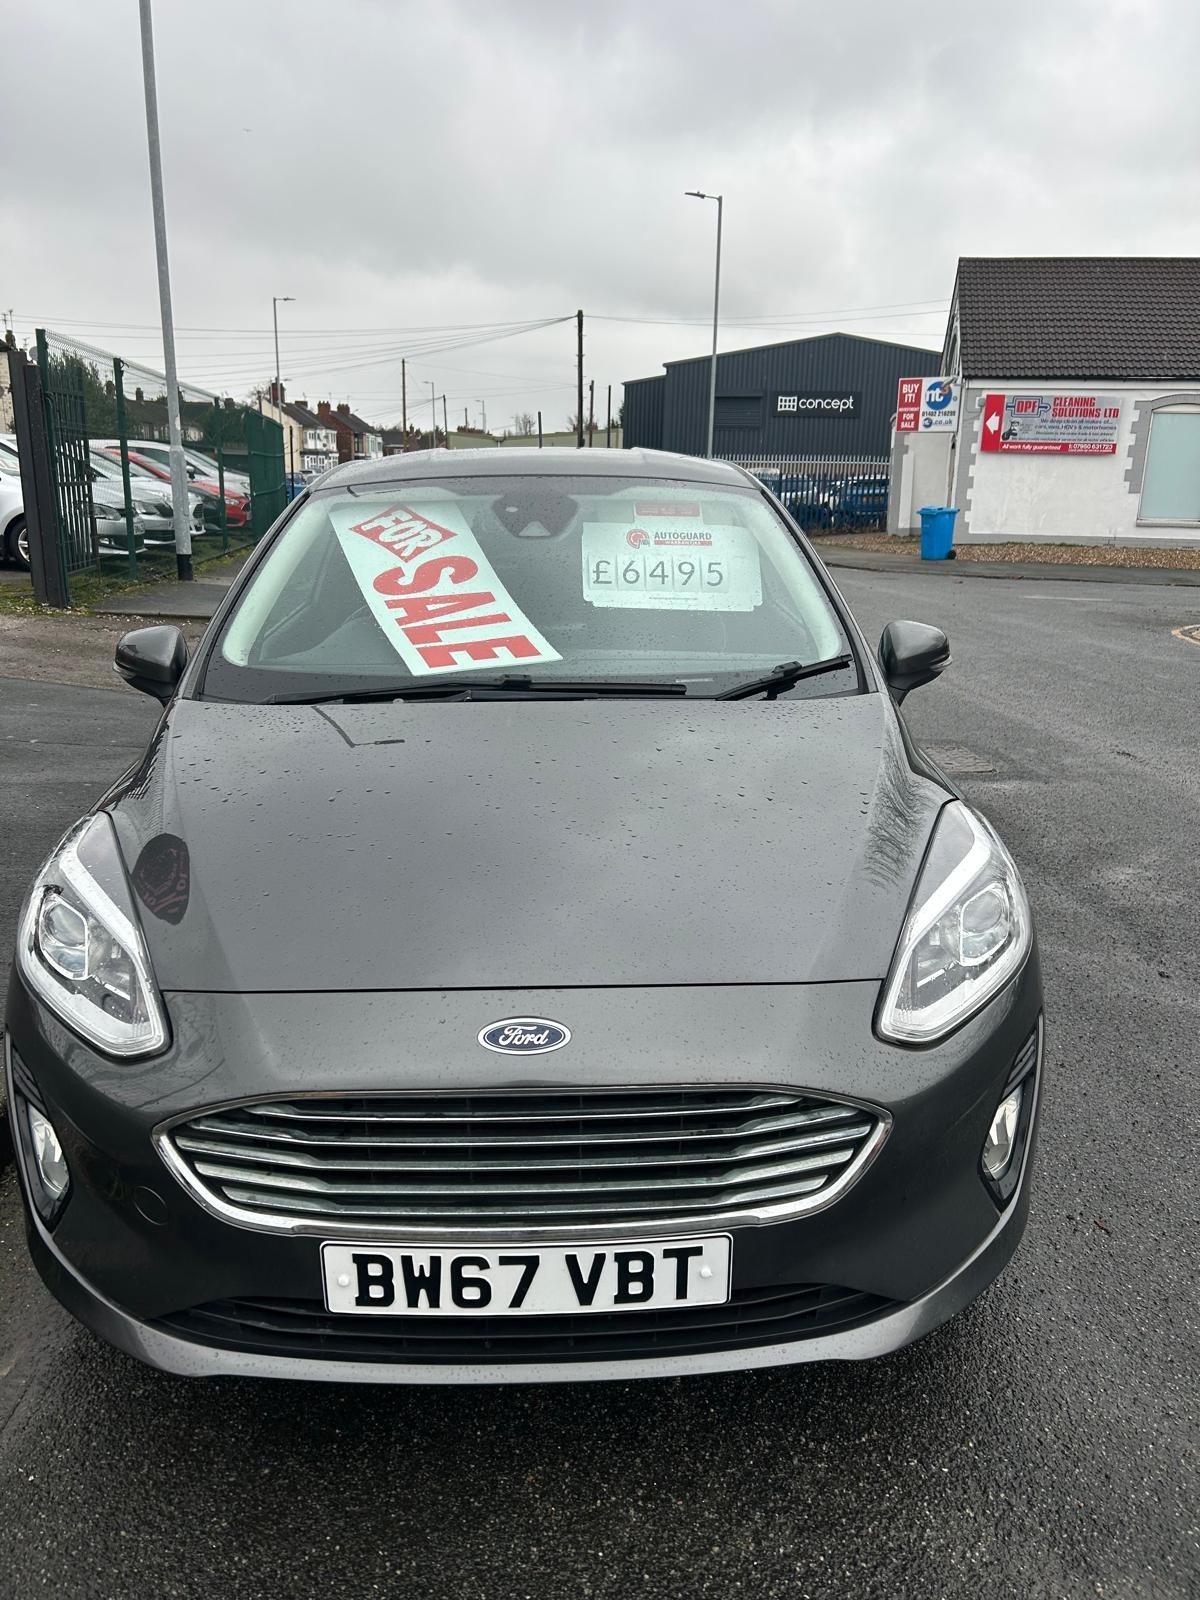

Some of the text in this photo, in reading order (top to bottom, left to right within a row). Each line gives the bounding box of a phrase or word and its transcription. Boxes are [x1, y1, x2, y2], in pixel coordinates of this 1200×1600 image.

[902, 384, 919, 393] BUY
[799, 396, 853, 412] concept
[905, 394, 915, 402] IT!
[1053, 397, 1096, 407] CLEANING
[1016, 400, 1037, 413] DPF
[1052, 407, 1120, 418] SOLUTIONS LTD
[654, 531, 712, 540] AUTOGUARD
[593, 560, 724, 587] £6495
[361, 509, 541, 668] FOR SALE
[498, 1025, 549, 1046] Ford
[352, 1245, 703, 1309] BW67 VBT
